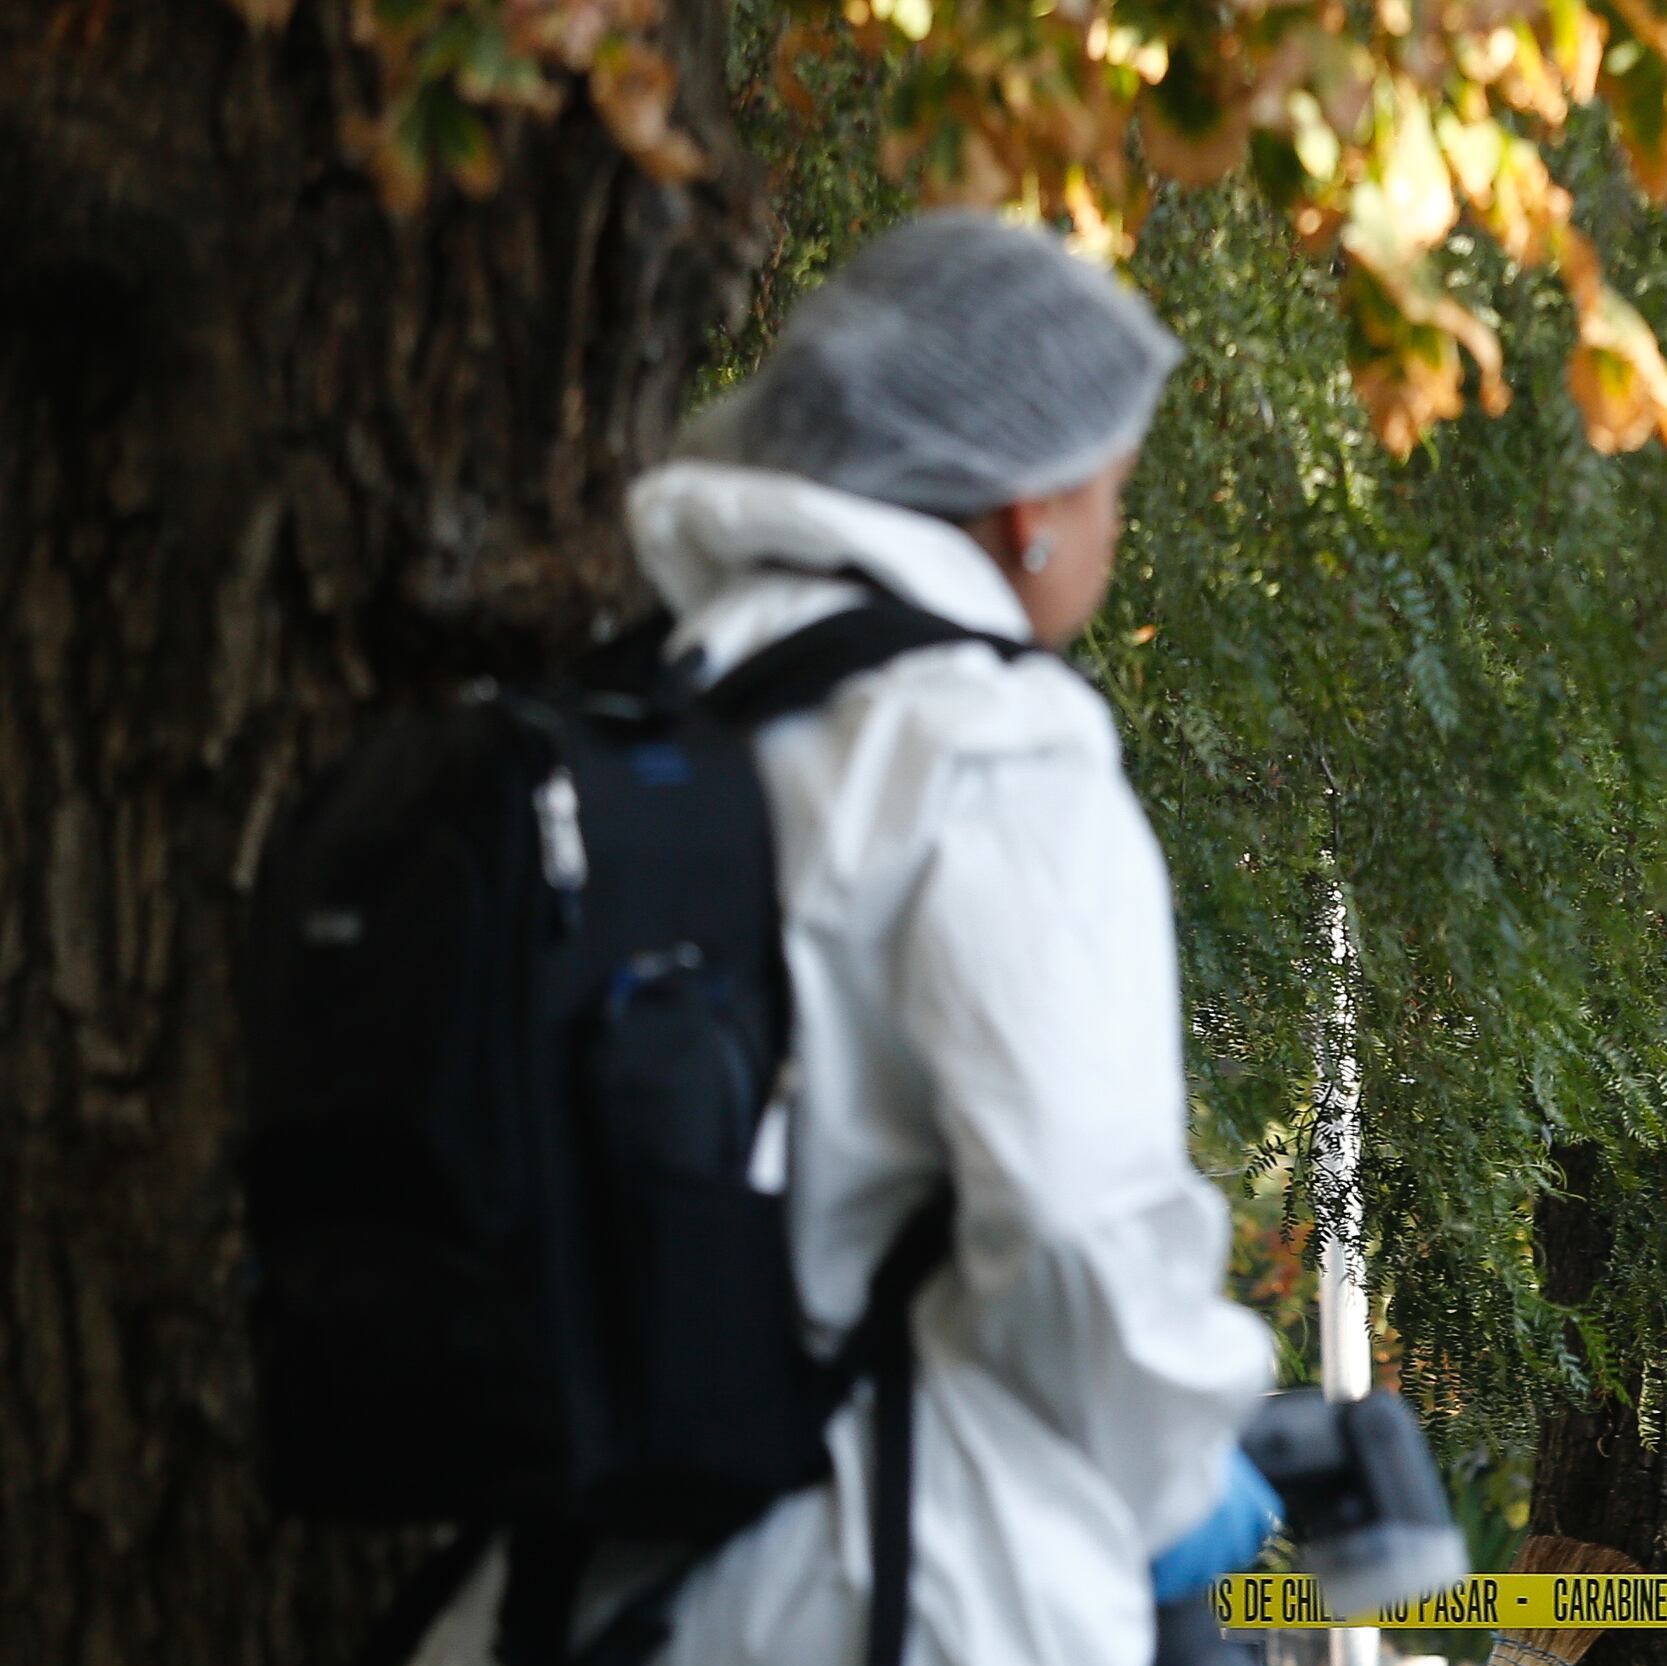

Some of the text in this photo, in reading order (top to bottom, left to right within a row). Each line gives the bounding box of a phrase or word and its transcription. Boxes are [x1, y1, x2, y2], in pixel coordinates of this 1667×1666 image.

[1243, 1577, 1274, 1623] DE
[1280, 1576, 1347, 1623] CHIL
[1416, 1578, 1499, 1624] PASAR
